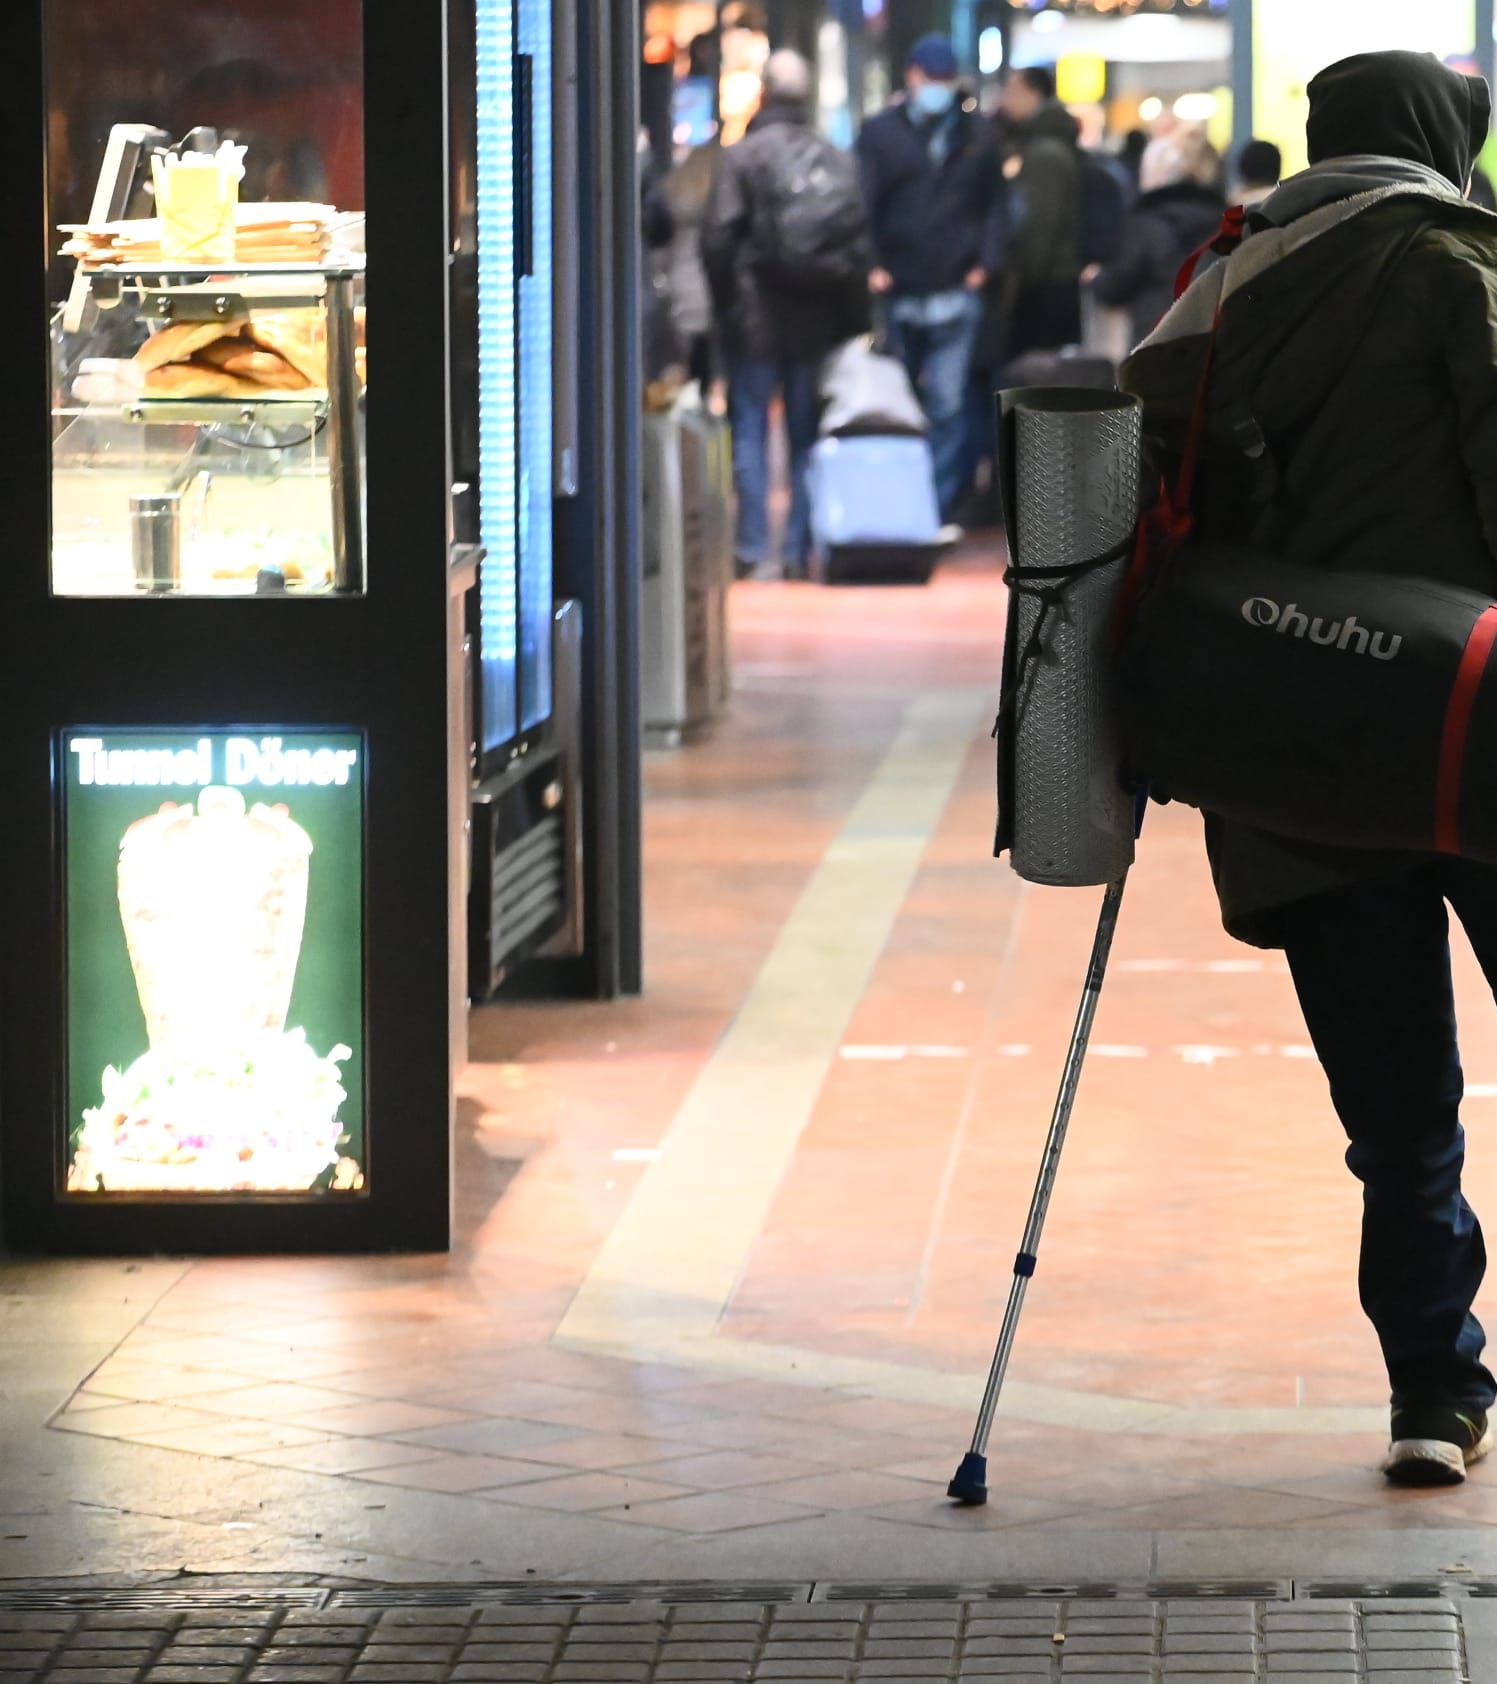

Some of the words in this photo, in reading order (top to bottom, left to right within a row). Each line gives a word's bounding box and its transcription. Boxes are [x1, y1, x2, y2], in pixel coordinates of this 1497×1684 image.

[1241, 597, 1402, 660] Ohuhu
[71, 738, 212, 785] Tunnel
[225, 738, 356, 785] Döner
